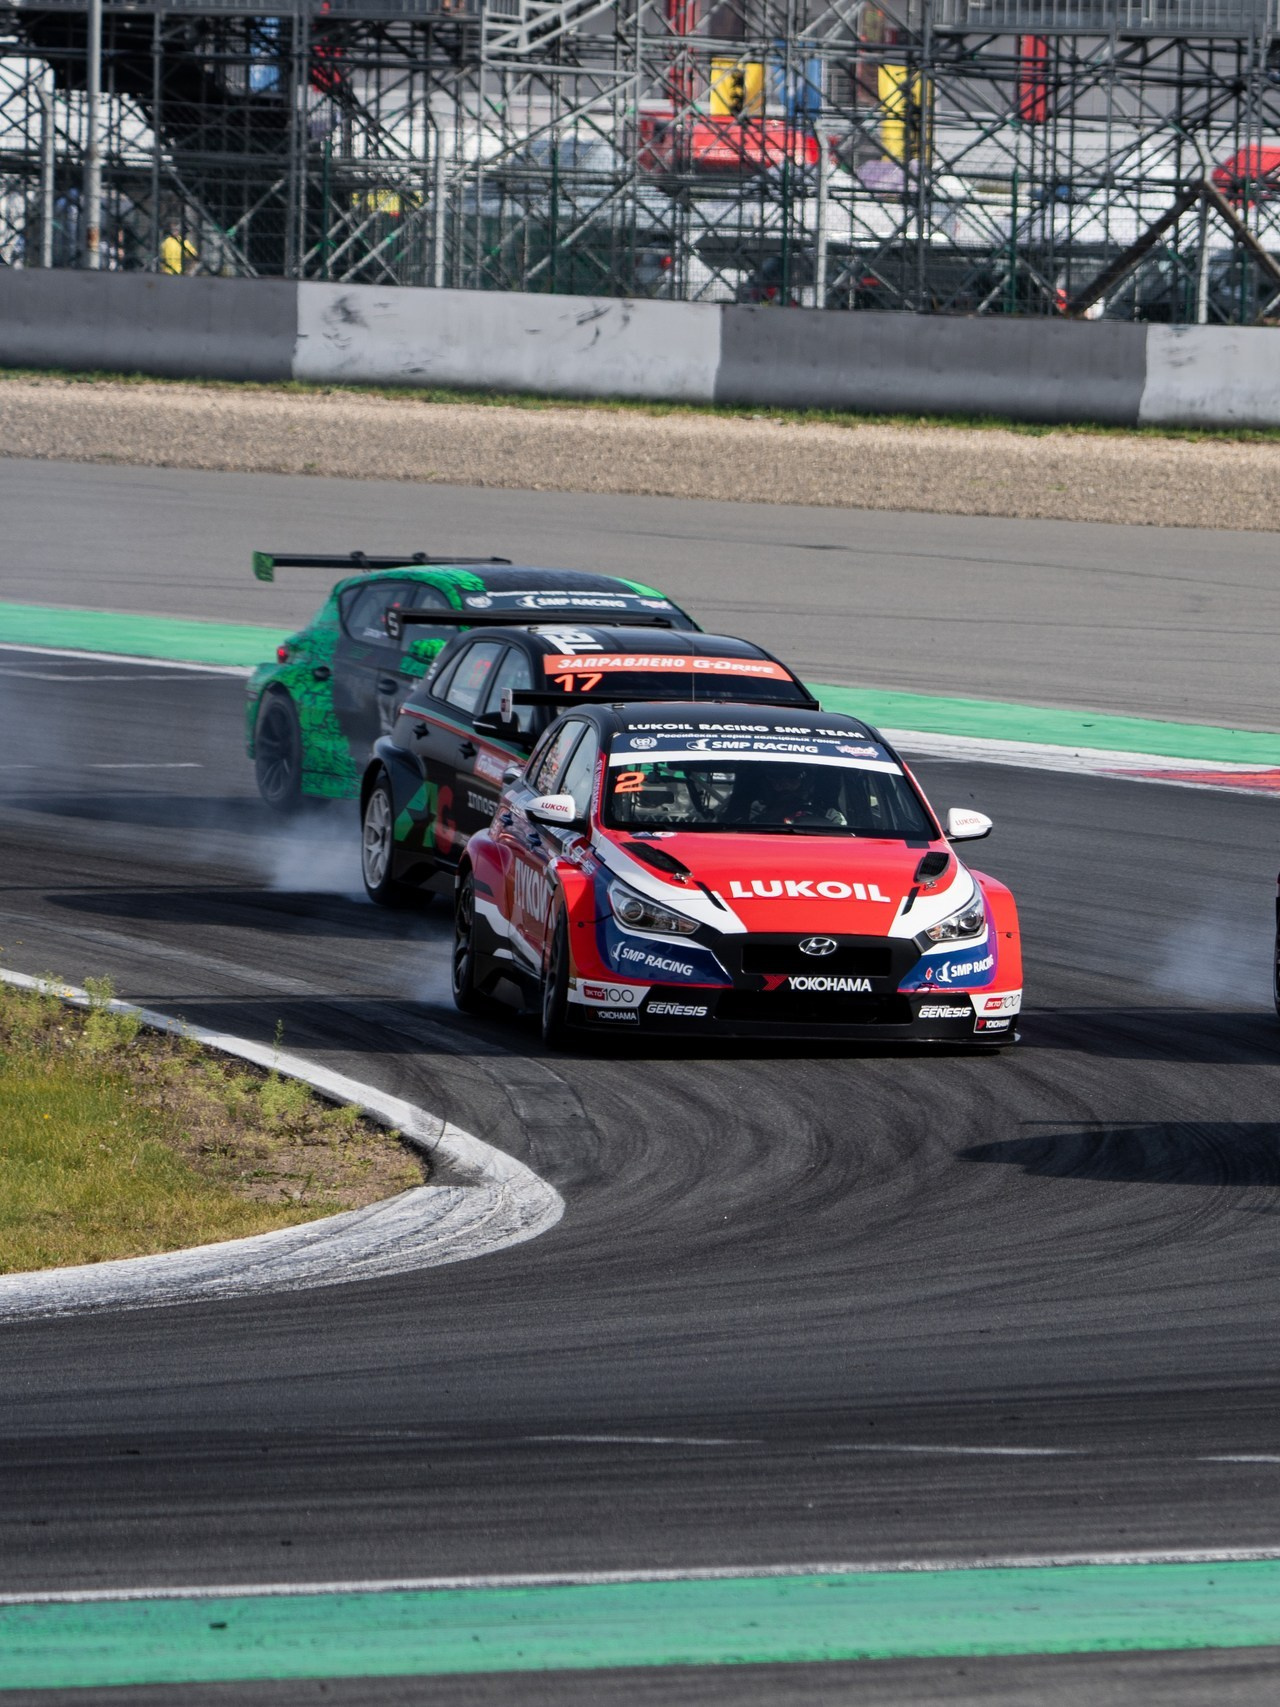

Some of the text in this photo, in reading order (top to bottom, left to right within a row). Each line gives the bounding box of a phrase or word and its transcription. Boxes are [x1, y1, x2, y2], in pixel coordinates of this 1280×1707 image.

[536, 597, 627, 608] SMP RACING
[557, 657, 686, 669] ЗАПРАВЛЕНО
[554, 673, 603, 692] 17
[628, 723, 866, 739] LUKOIL RACING SMP TEAM
[711, 741, 819, 753] SMP RACING
[614, 771, 646, 793] 2
[541, 801, 569, 813] LUKOIL
[955, 817, 981, 826] LUKOIL
[729, 880, 891, 903] LUKOIL
[620, 947, 694, 976] SMP RACING
[950, 961, 973, 978] SMP
[788, 976, 872, 992] YOKOHAMA
[597, 1010, 637, 1021] YOKOHAMA
[646, 1004, 708, 1017] GENESIS
[918, 1007, 972, 1018] GENESIS
